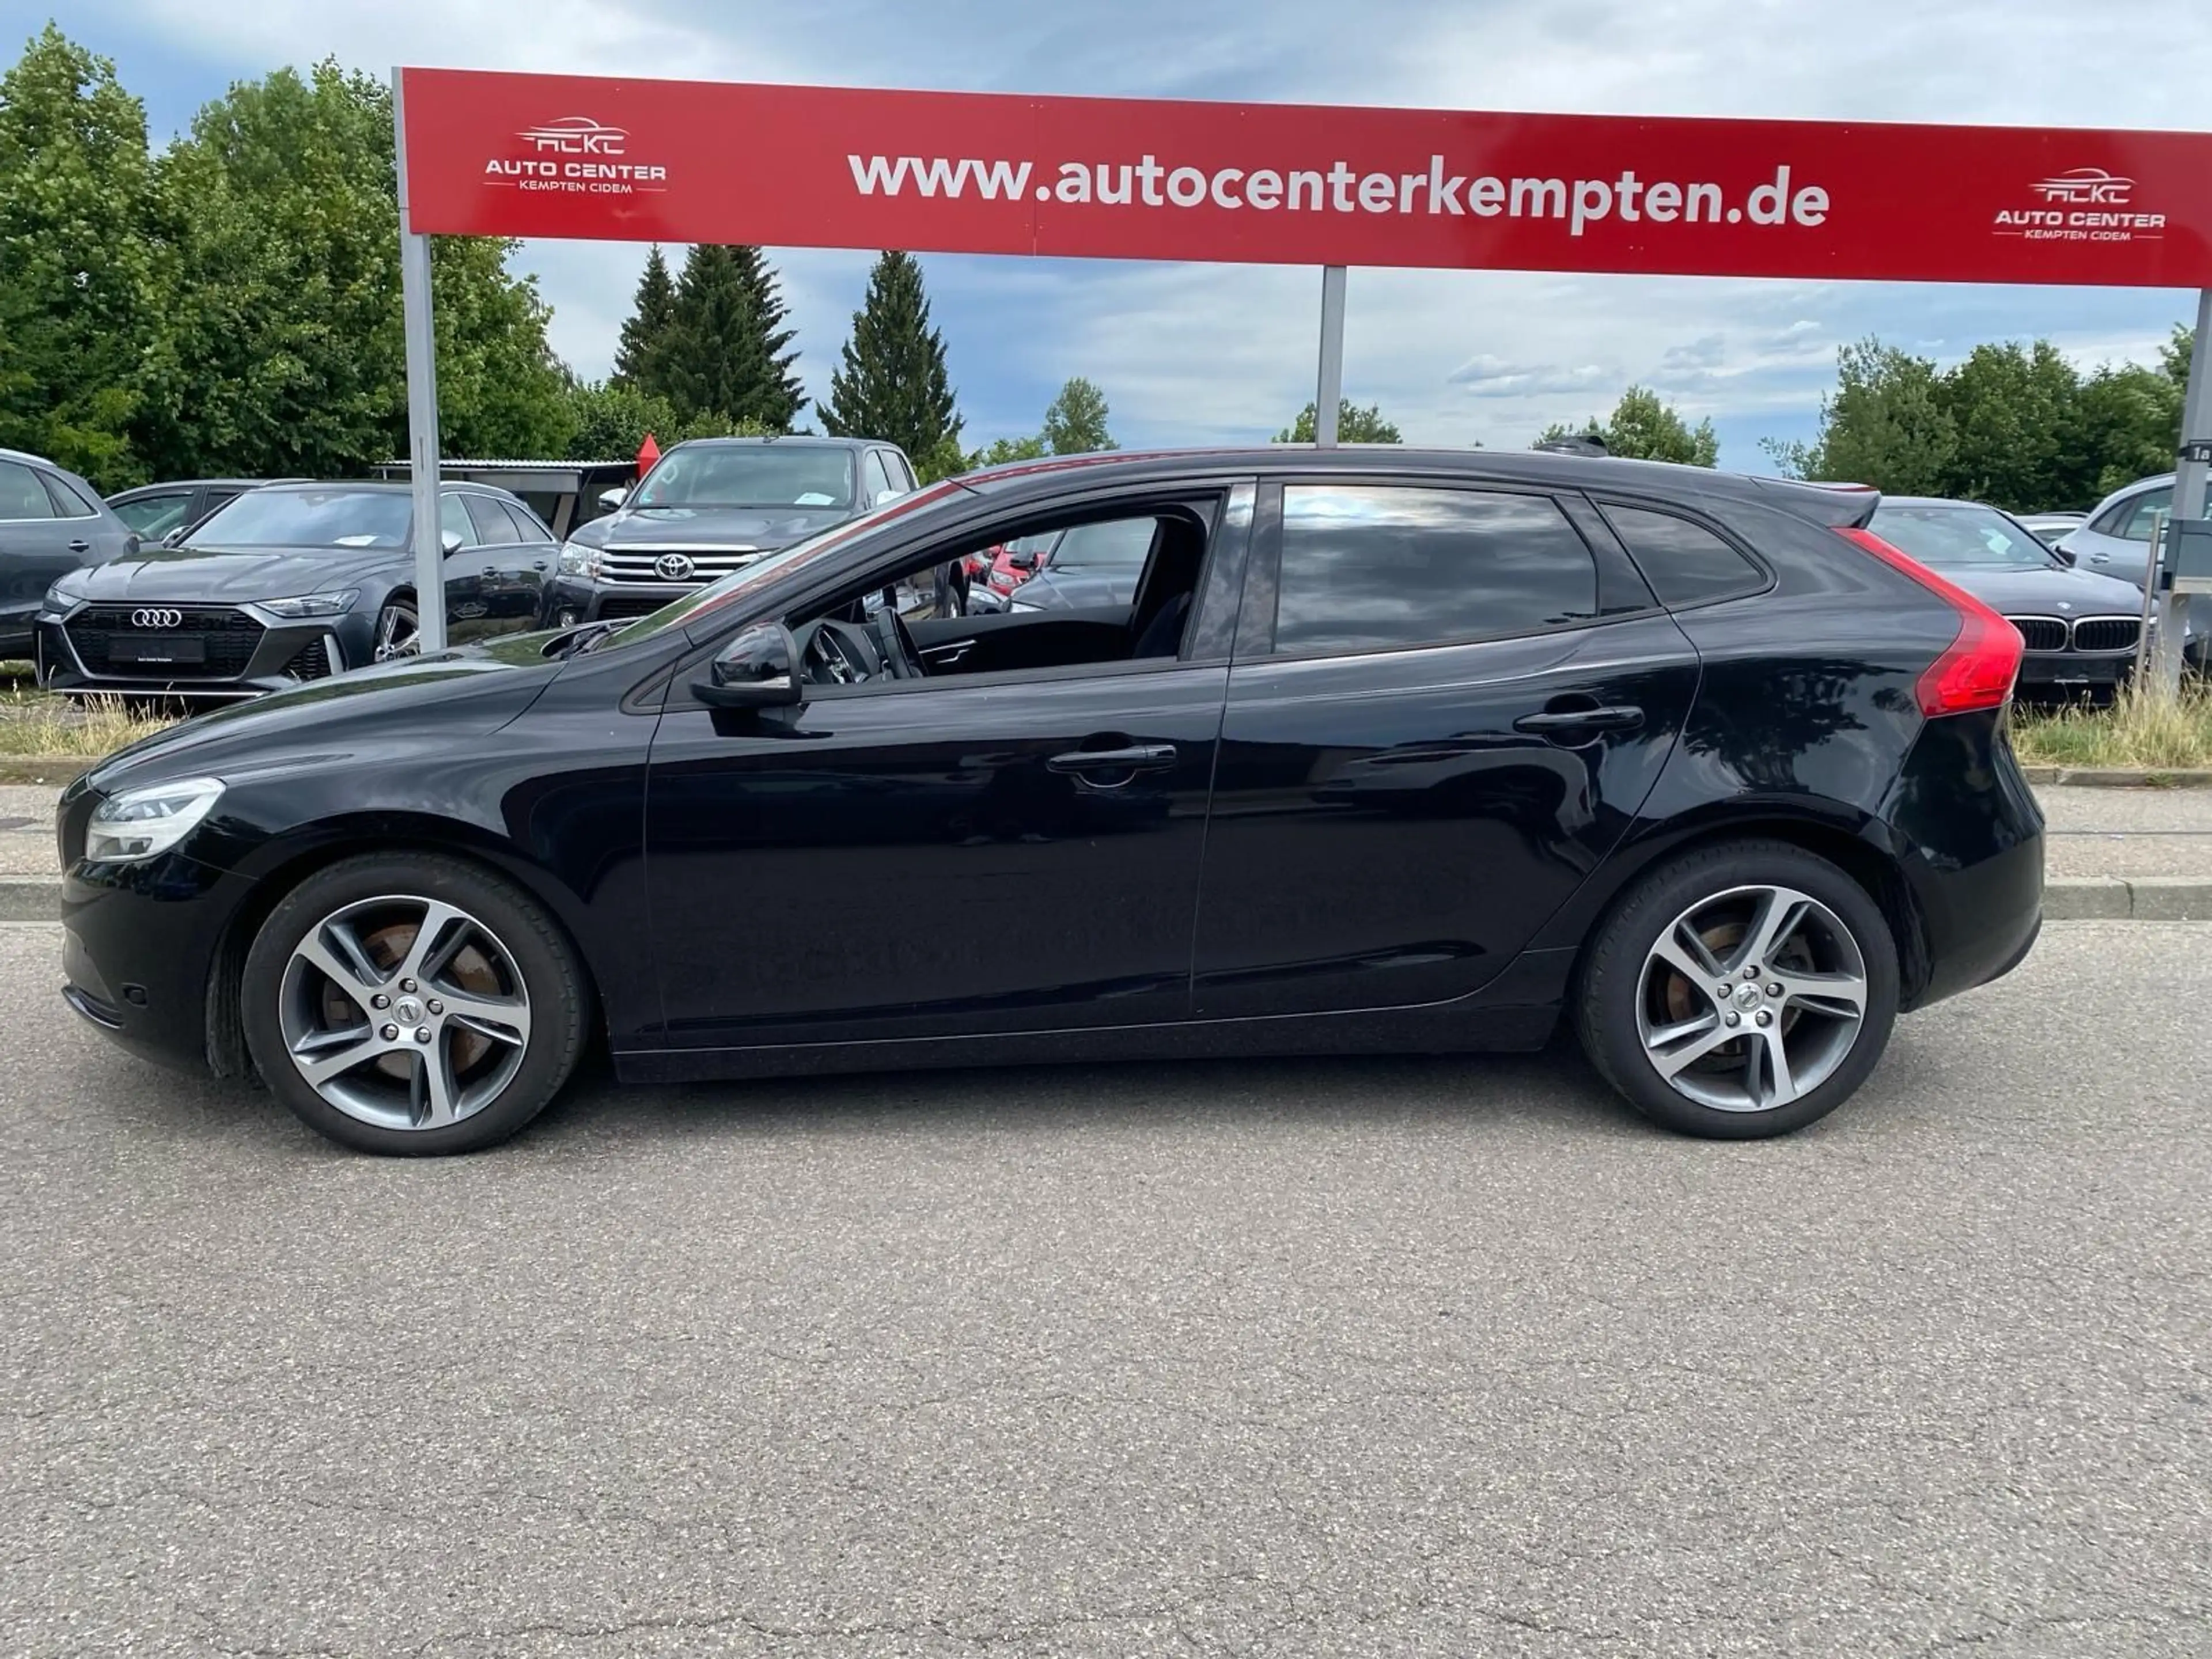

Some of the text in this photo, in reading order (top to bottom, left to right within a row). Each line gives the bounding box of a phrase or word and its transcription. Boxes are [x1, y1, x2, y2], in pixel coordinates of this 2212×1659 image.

[485, 160, 666, 180] AUTO CENTER
[519, 180, 632, 194] KEMPTEN CIDEM
[847, 154, 1831, 236] www.autocenterkempten.de
[1994, 210, 2166, 228] AUTO CENTER
[2024, 229, 2131, 241] KEMPTEN CIDEM
